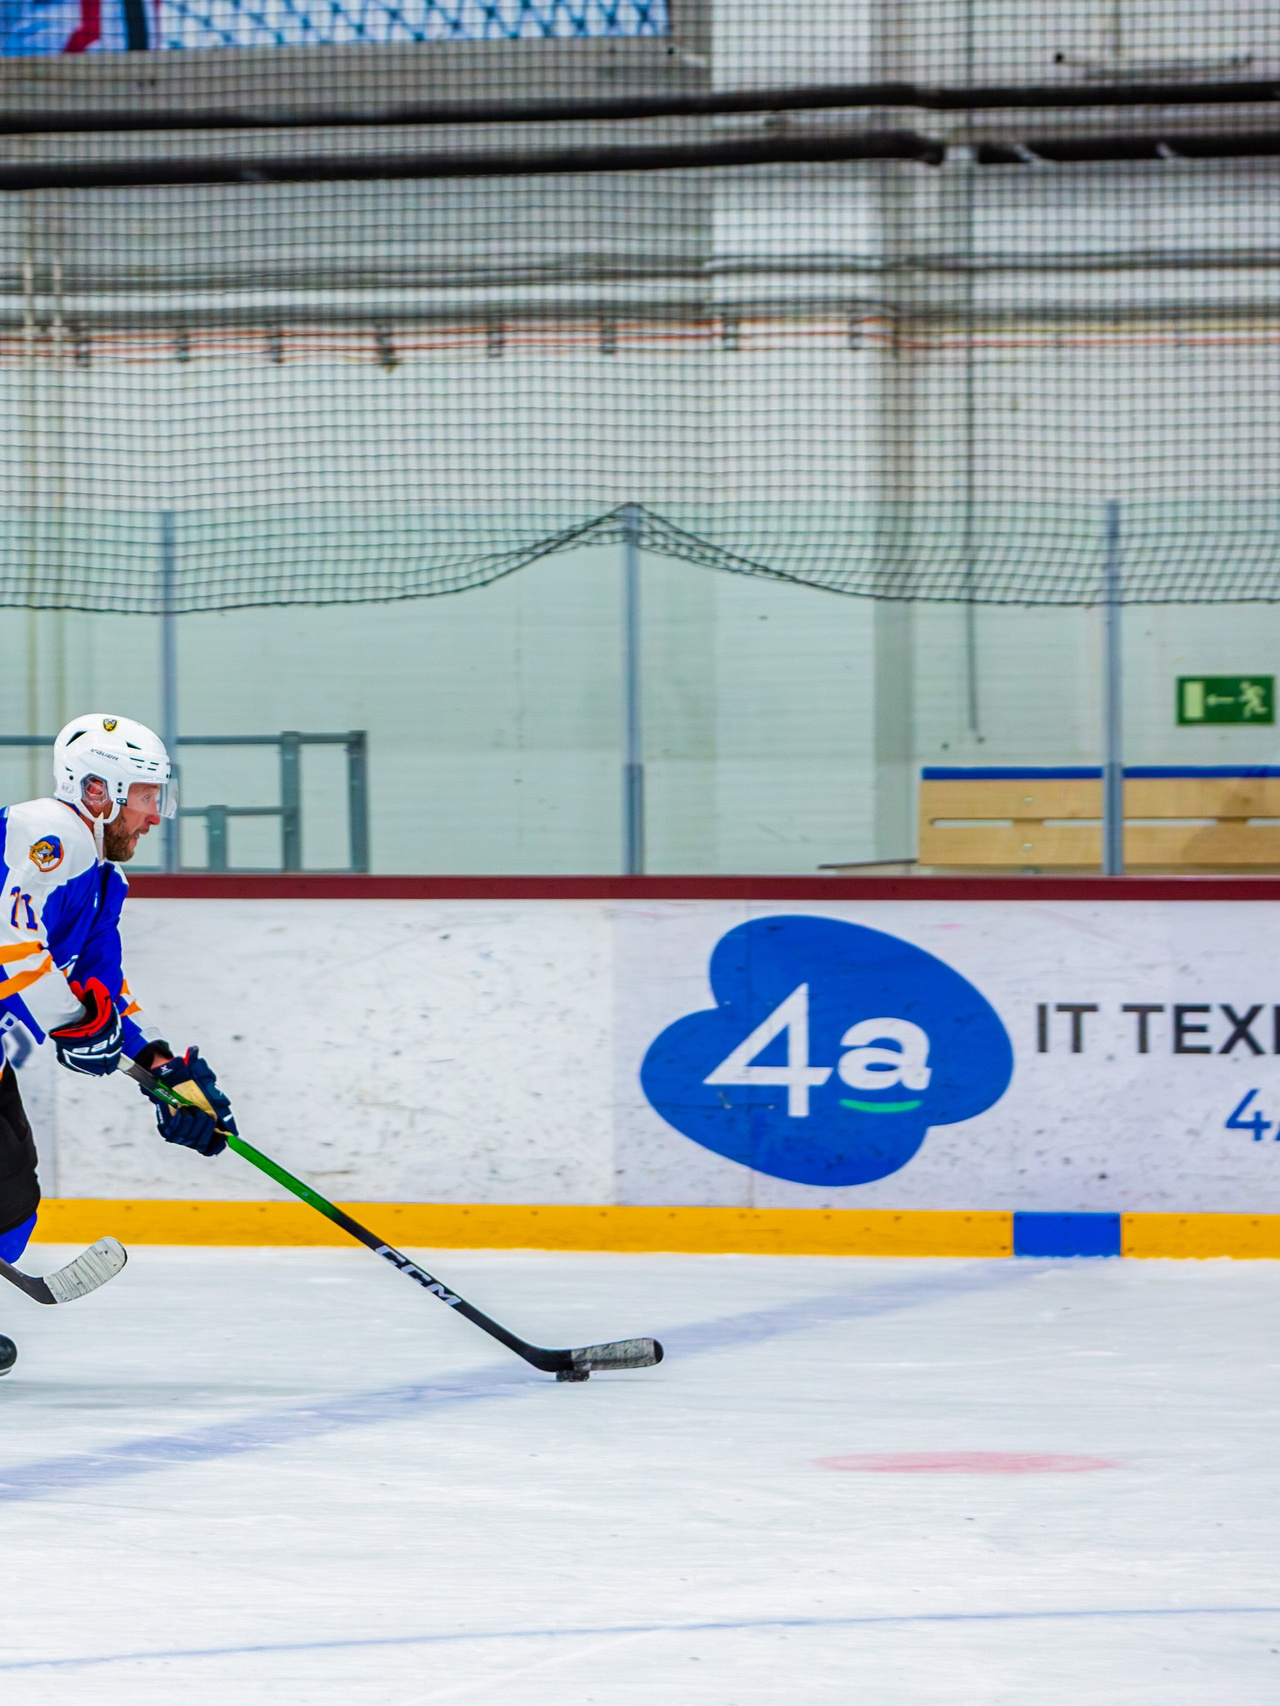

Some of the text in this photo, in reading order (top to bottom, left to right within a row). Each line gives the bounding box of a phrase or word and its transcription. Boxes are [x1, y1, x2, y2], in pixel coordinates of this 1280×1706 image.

[1037, 1003, 1280, 1055] IT ТЕХ
[1224, 1087, 1280, 1142] 4
[375, 1244, 462, 1306] CCM
